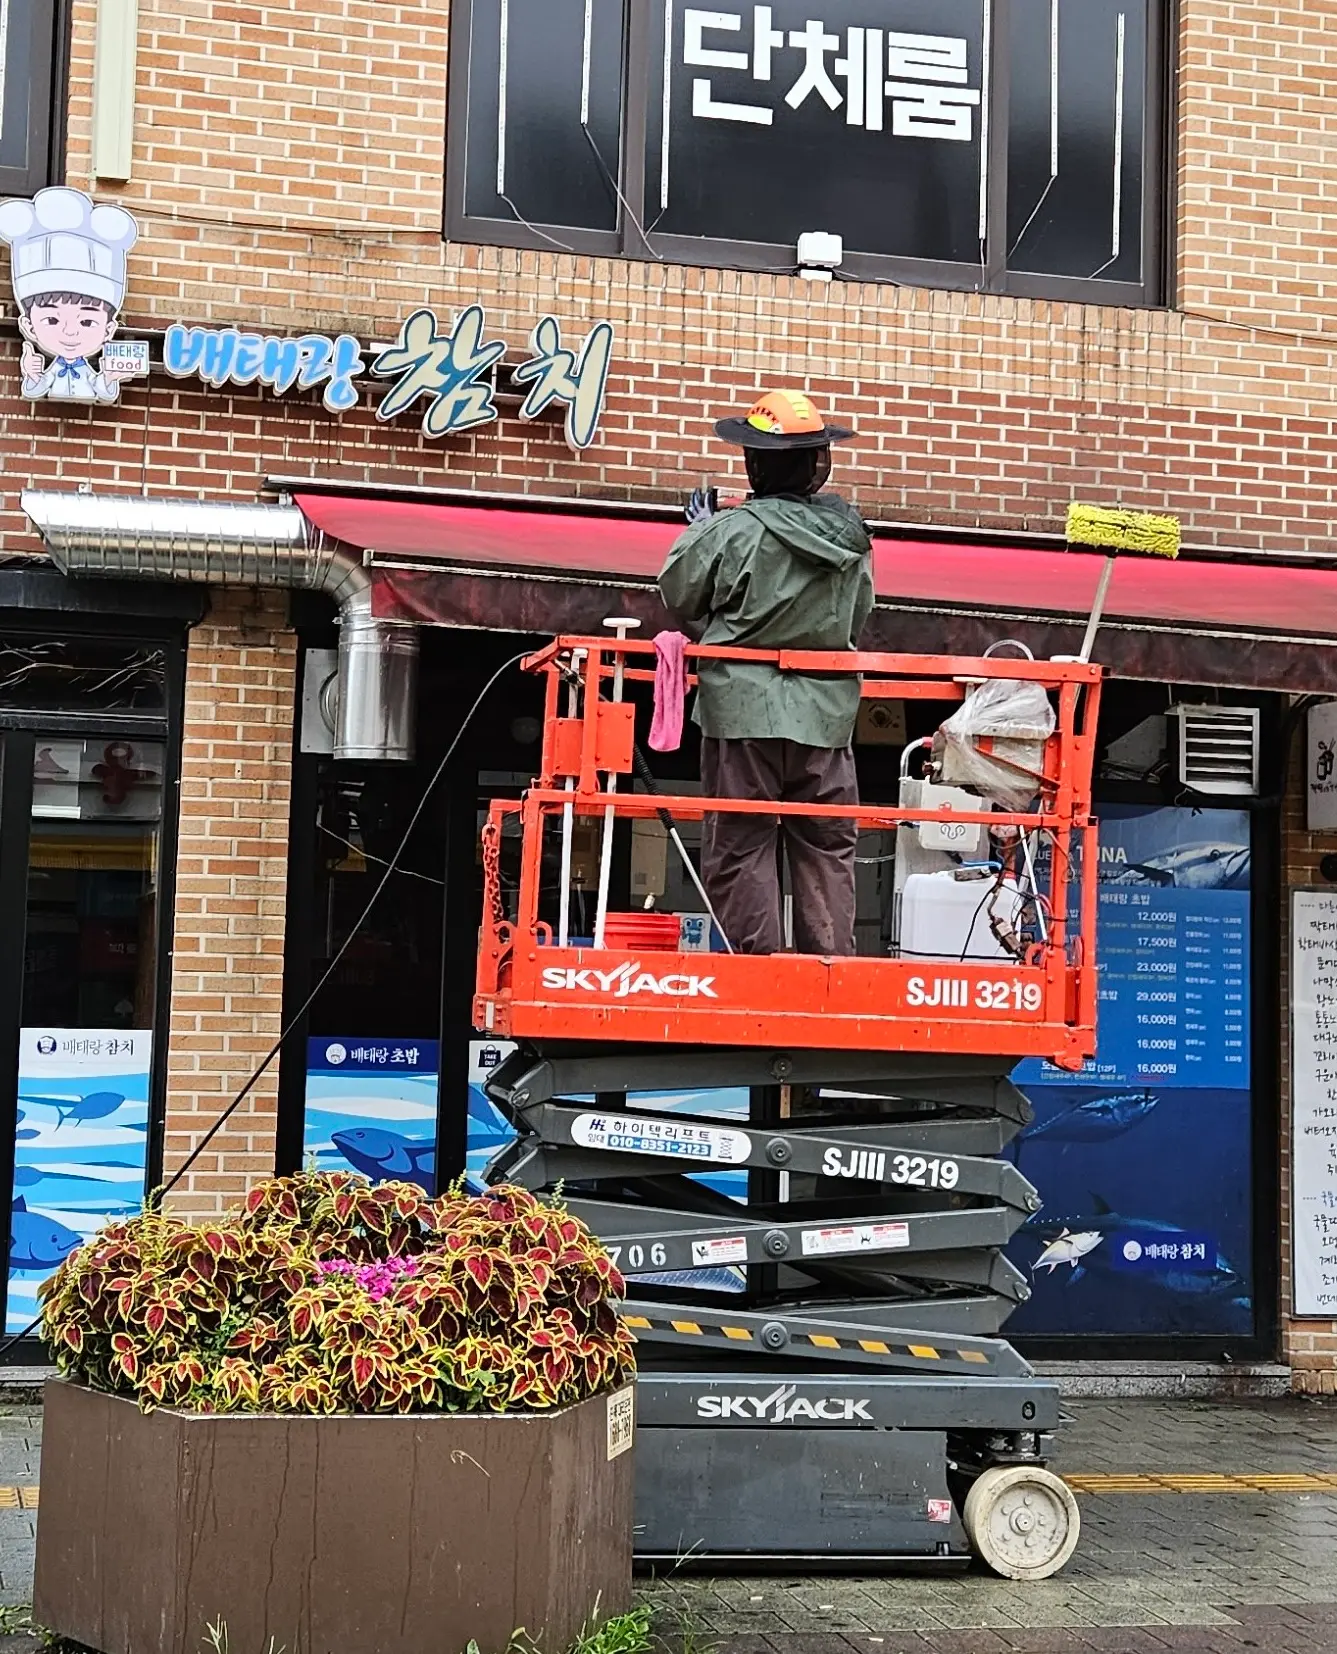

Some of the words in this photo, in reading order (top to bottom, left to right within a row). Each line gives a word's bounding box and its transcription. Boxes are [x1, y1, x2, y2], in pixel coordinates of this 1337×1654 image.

[683, 5, 981, 141] 단체룸
[105, 343, 145, 358] 배태랑
[110, 359, 142, 370] food
[166, 325, 363, 409] 배태랑
[373, 306, 611, 449] 참치
[1076, 845, 1128, 863] TNA
[1138, 912, 1176, 923] 12,000원
[1138, 937, 1176, 948] 17,500원
[1137, 962, 1176, 973] 23,000원
[541, 961, 719, 998] SKYJACK
[906, 976, 968, 1007] SJIII
[975, 981, 1042, 1012] 3219
[1137, 992, 1176, 1002] 29,000원
[1137, 1015, 1176, 1025] 16,000원
[62, 1039, 102, 1056] 배태랑
[106, 1038, 135, 1057] 참치
[1138, 1039, 1176, 1050] 16,000원
[350, 1047, 389, 1064] 배태랑
[390, 1046, 420, 1065] 초밥
[1138, 1064, 1176, 1074] 16,000원
[609, 1135, 710, 1156] 010-8351-2123
[821, 1147, 885, 1182] SJIII
[892, 1155, 959, 1189] 3219
[1145, 1243, 1179, 1259] 배태랑
[1180, 1243, 1205, 1260] 참치
[697, 1384, 874, 1423] SKYJACK
